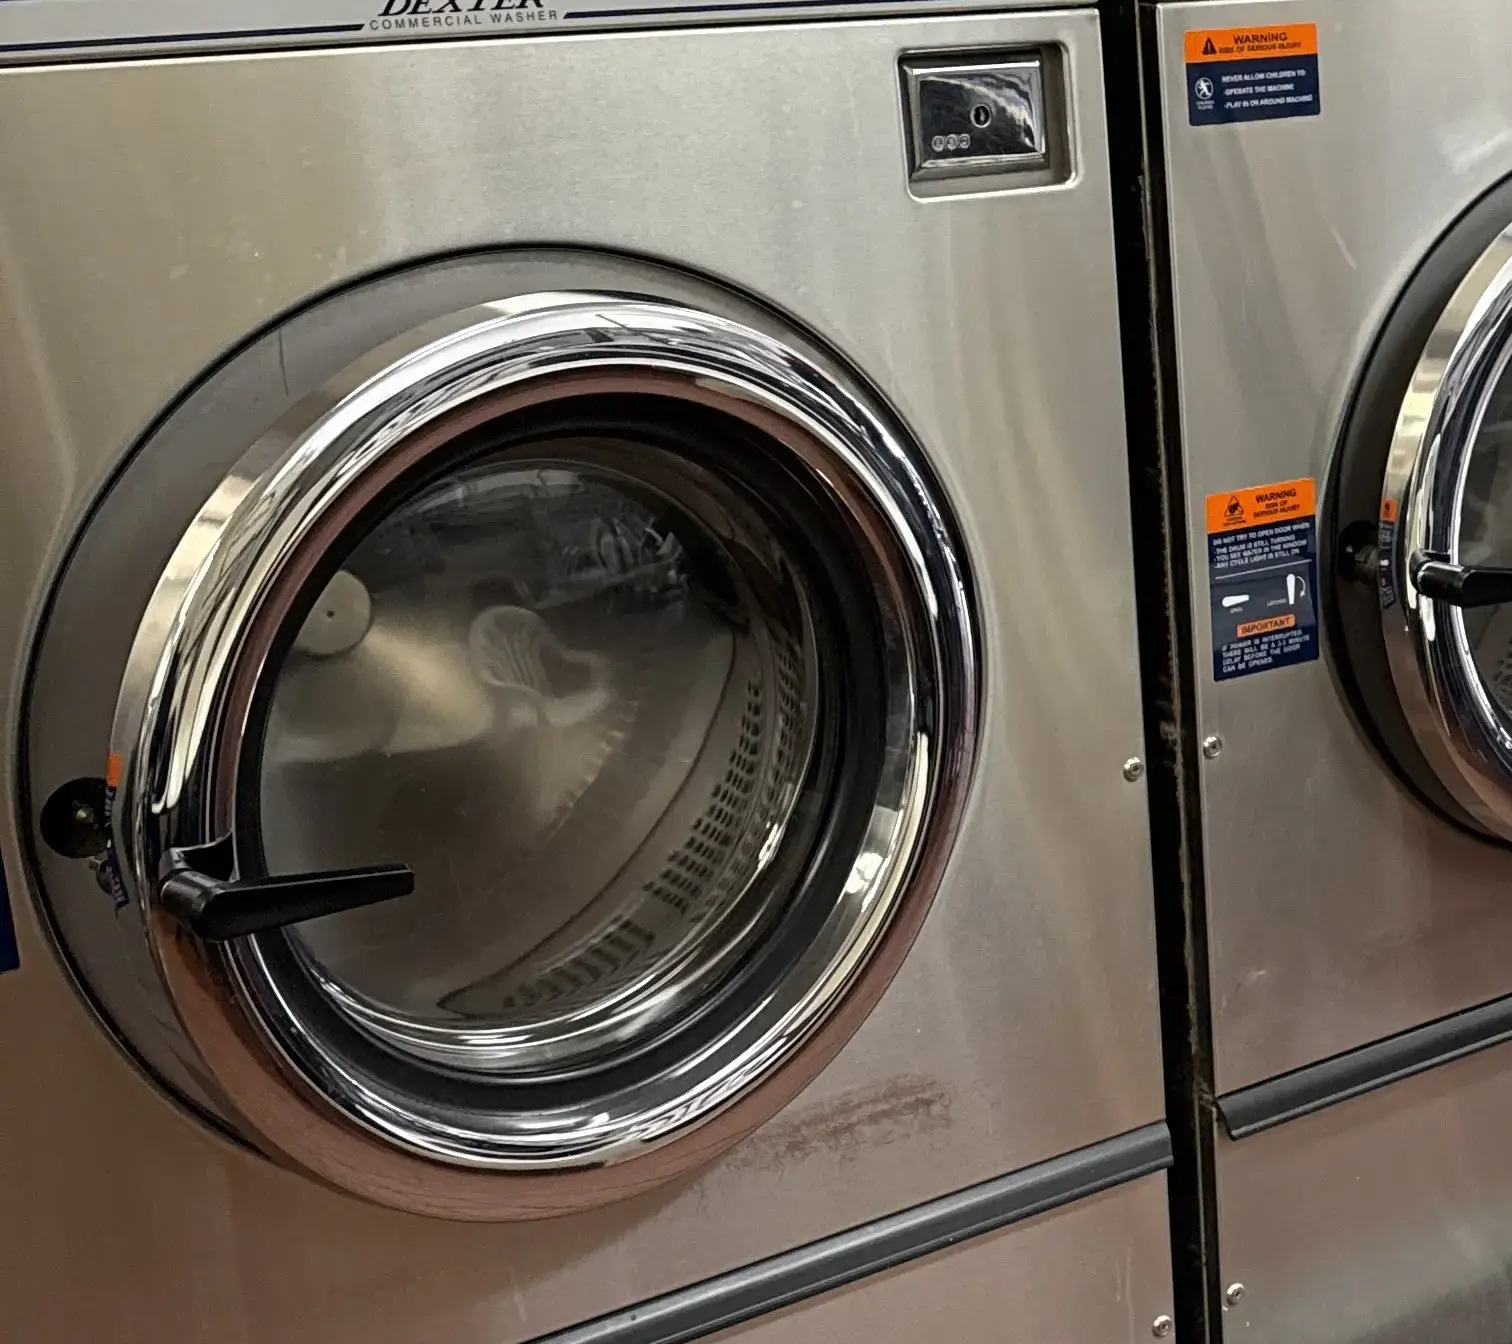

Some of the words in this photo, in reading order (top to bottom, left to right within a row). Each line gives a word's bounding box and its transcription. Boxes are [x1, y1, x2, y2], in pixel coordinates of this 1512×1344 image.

[369, 15, 482, 31] COMMERCIAL
[491, 10, 558, 24] WASHER
[1233, 32, 1287, 44] WARNING
[1256, 488, 1296, 503] WARNING
[1242, 617, 1290, 635] IMPORTANT
